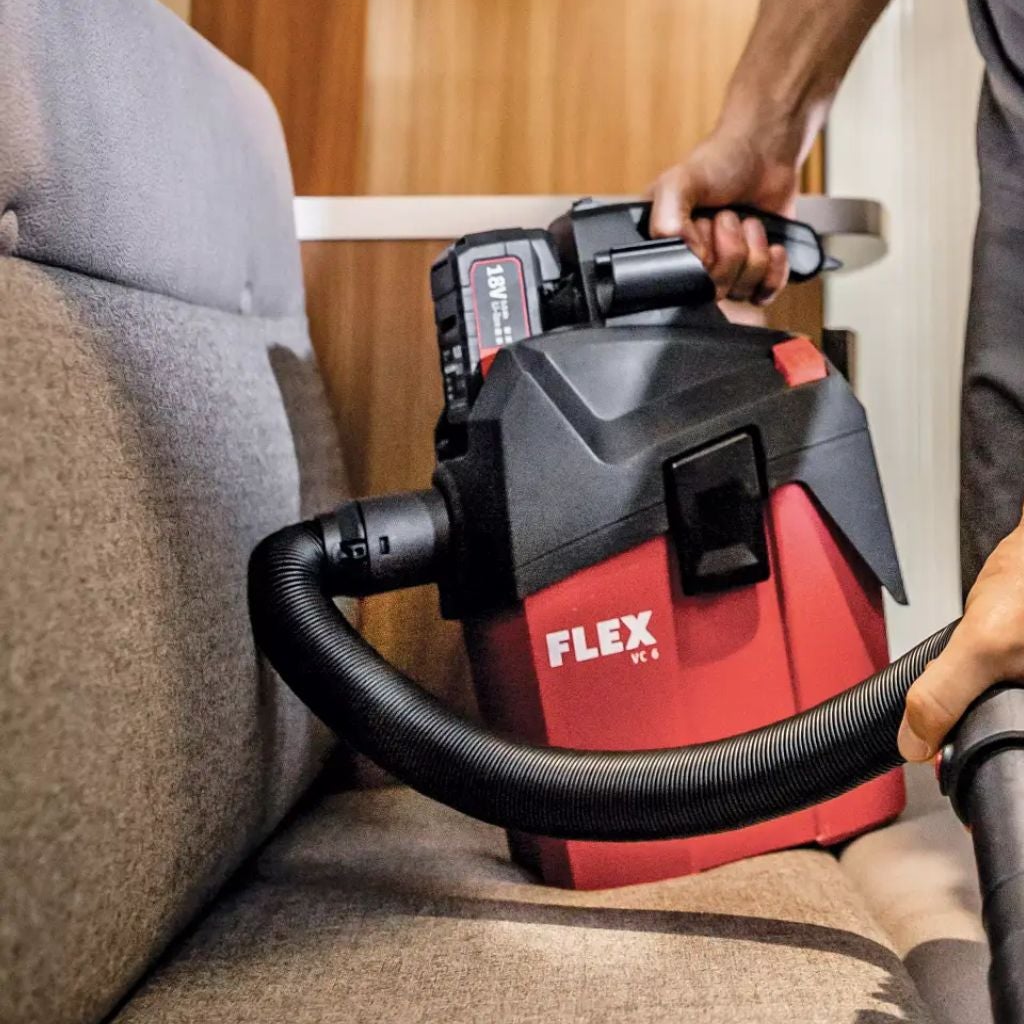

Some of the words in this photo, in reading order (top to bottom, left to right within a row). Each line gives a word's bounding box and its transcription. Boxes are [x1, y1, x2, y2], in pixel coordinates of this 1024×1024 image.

[486, 264, 508, 300] 18V
[545, 610, 657, 668] FLEX
[630, 650, 648, 664] VC
